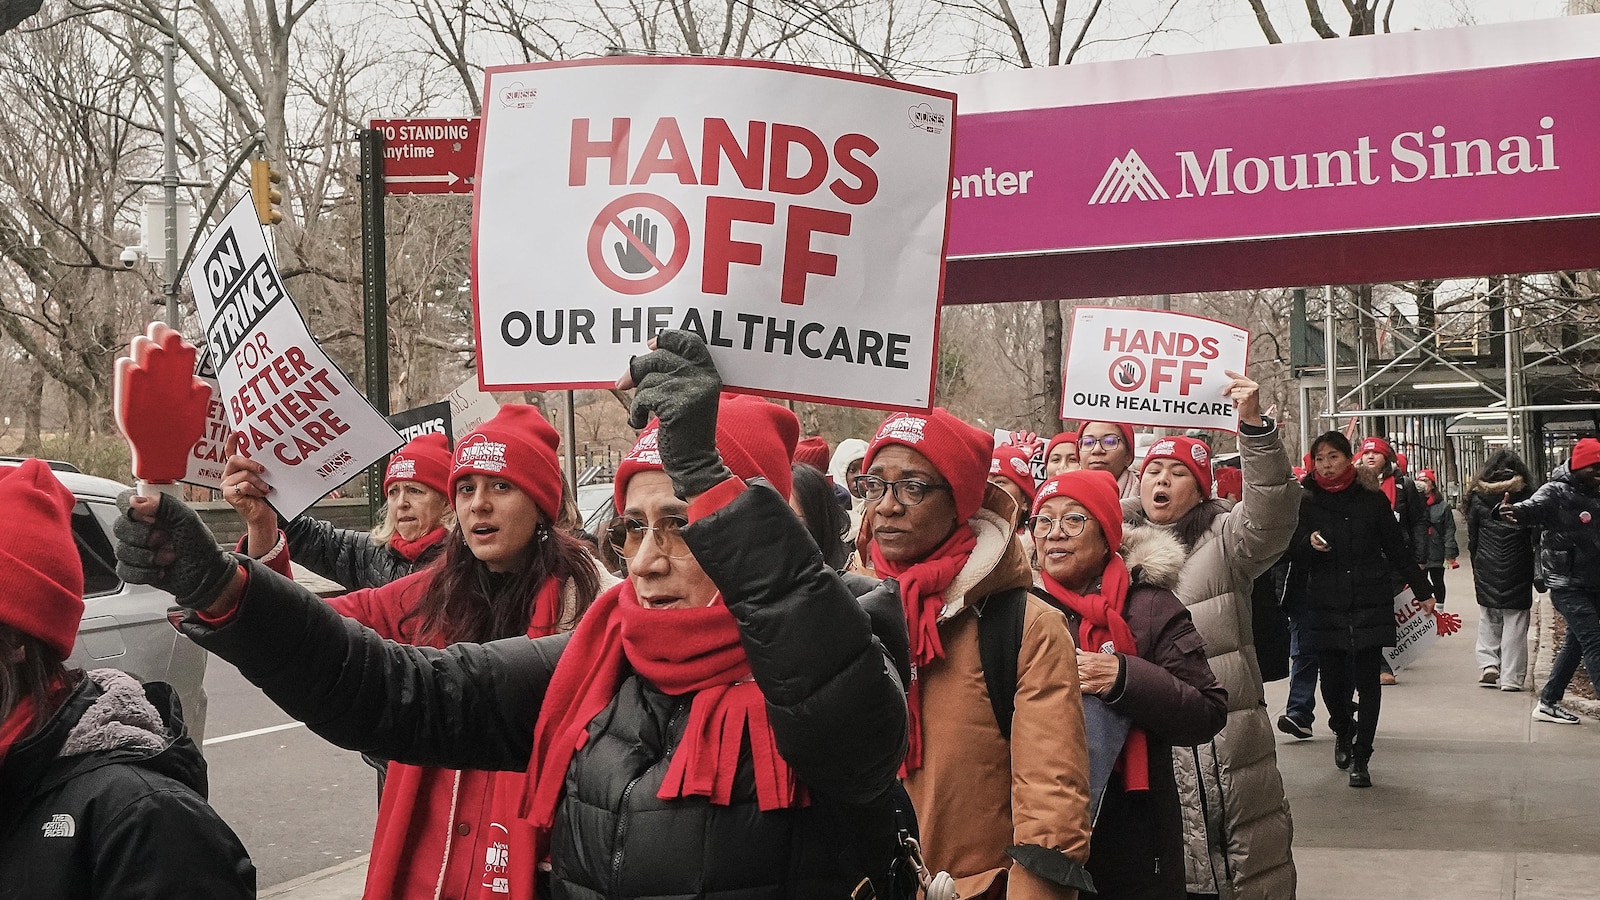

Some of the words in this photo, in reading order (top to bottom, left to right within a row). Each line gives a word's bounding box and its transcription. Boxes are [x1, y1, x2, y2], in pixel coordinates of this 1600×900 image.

[399, 125, 469, 140] STANDING
[568, 116, 879, 205] HANDS
[1175, 135, 1379, 199] Mount
[1390, 116, 1559, 184] Sinai
[208, 237, 242, 298] ON
[209, 261, 279, 368] STRIKE
[500, 308, 596, 347] OUR
[611, 306, 912, 370] HEALTHCARE
[1103, 327, 1220, 360] HANDS
[234, 331, 274, 379] FOR
[230, 346, 315, 425] BETTER
[236, 368, 341, 459] PATIENT
[1073, 392, 1111, 408] OUR
[1116, 396, 1233, 417] HEALTHCARE
[273, 408, 351, 466] CARE
[1388, 638, 1413, 660] LABOR
[1410, 619, 1435, 642] UNFAIR
